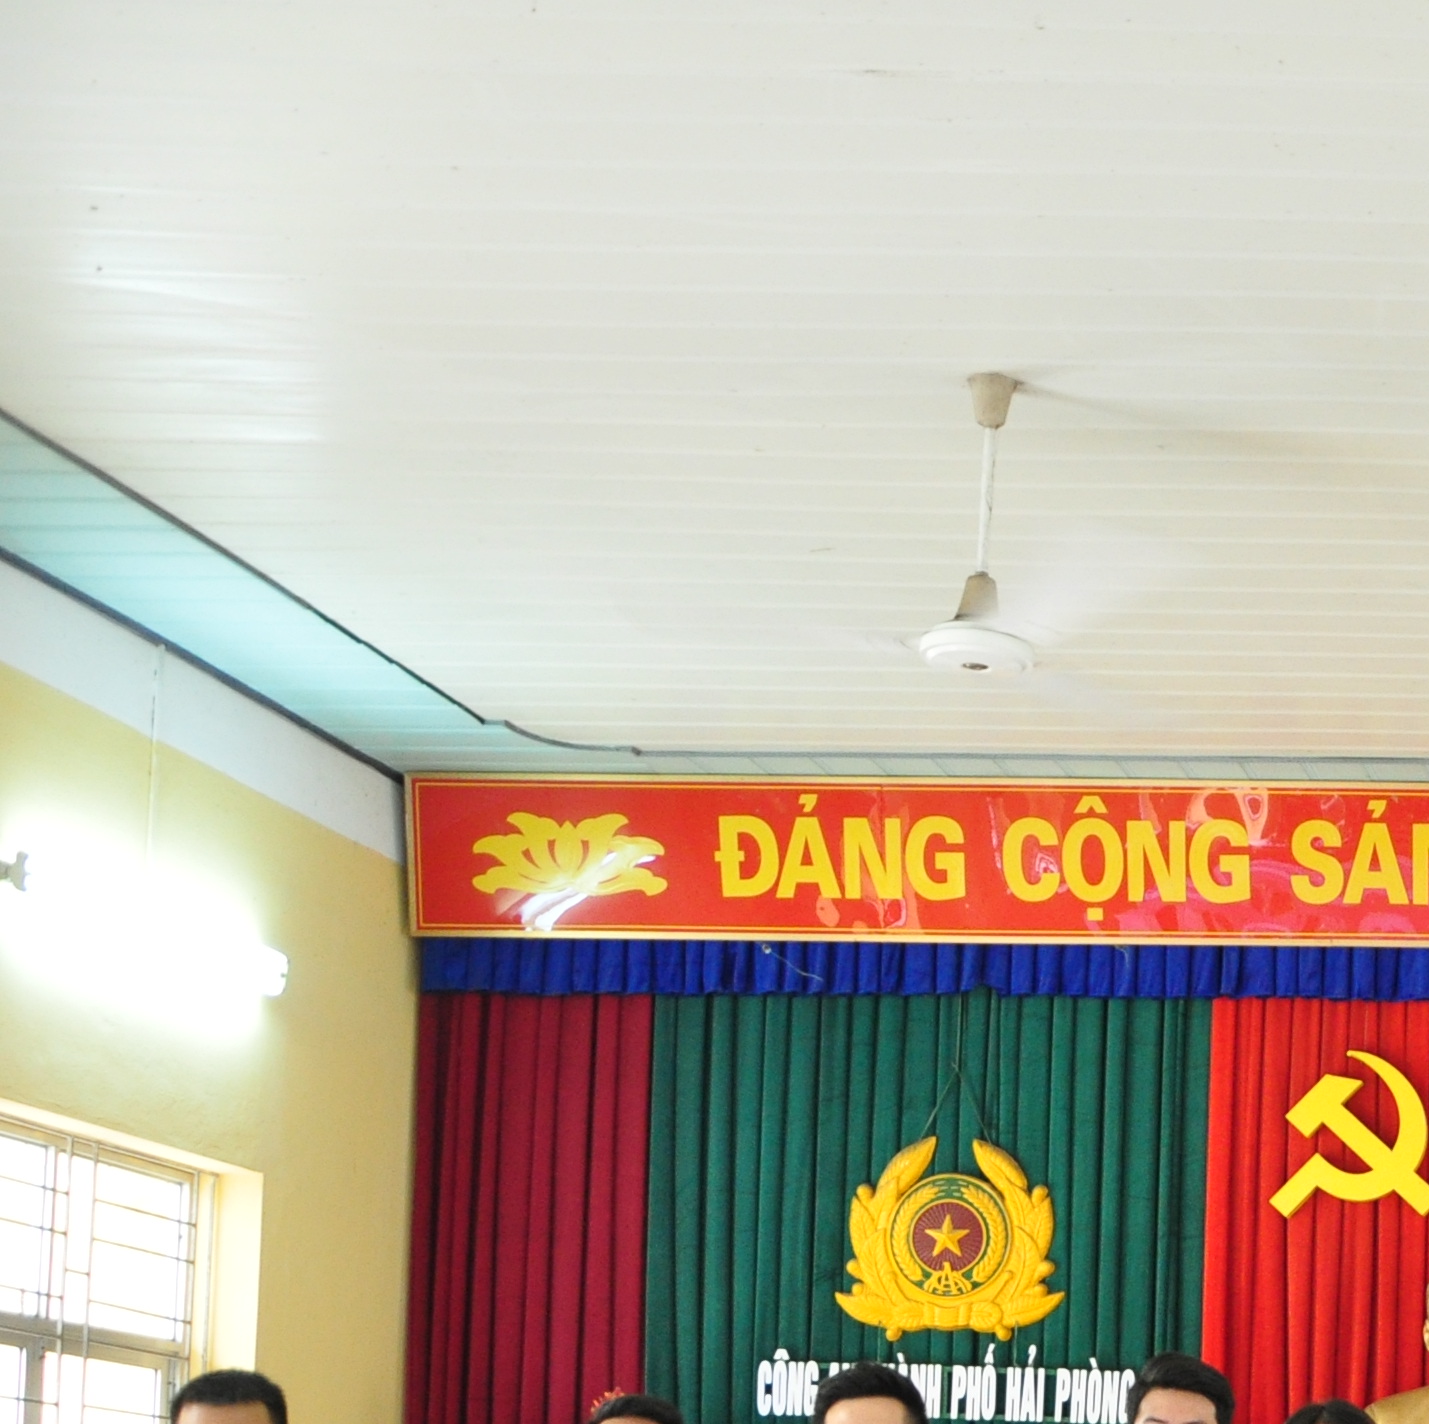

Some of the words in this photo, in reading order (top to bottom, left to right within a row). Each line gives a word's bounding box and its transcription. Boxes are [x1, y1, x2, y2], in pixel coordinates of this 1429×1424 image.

[715, 794, 965, 900] ĐẢNG
[1002, 795, 1251, 921] CỘNG
[757, 1349, 819, 1416] CÔNG
[950, 1344, 996, 1420] PHỐ
[1005, 1345, 1045, 1422] HẢI
[1054, 1357, 1135, 1424] PHÒNG
